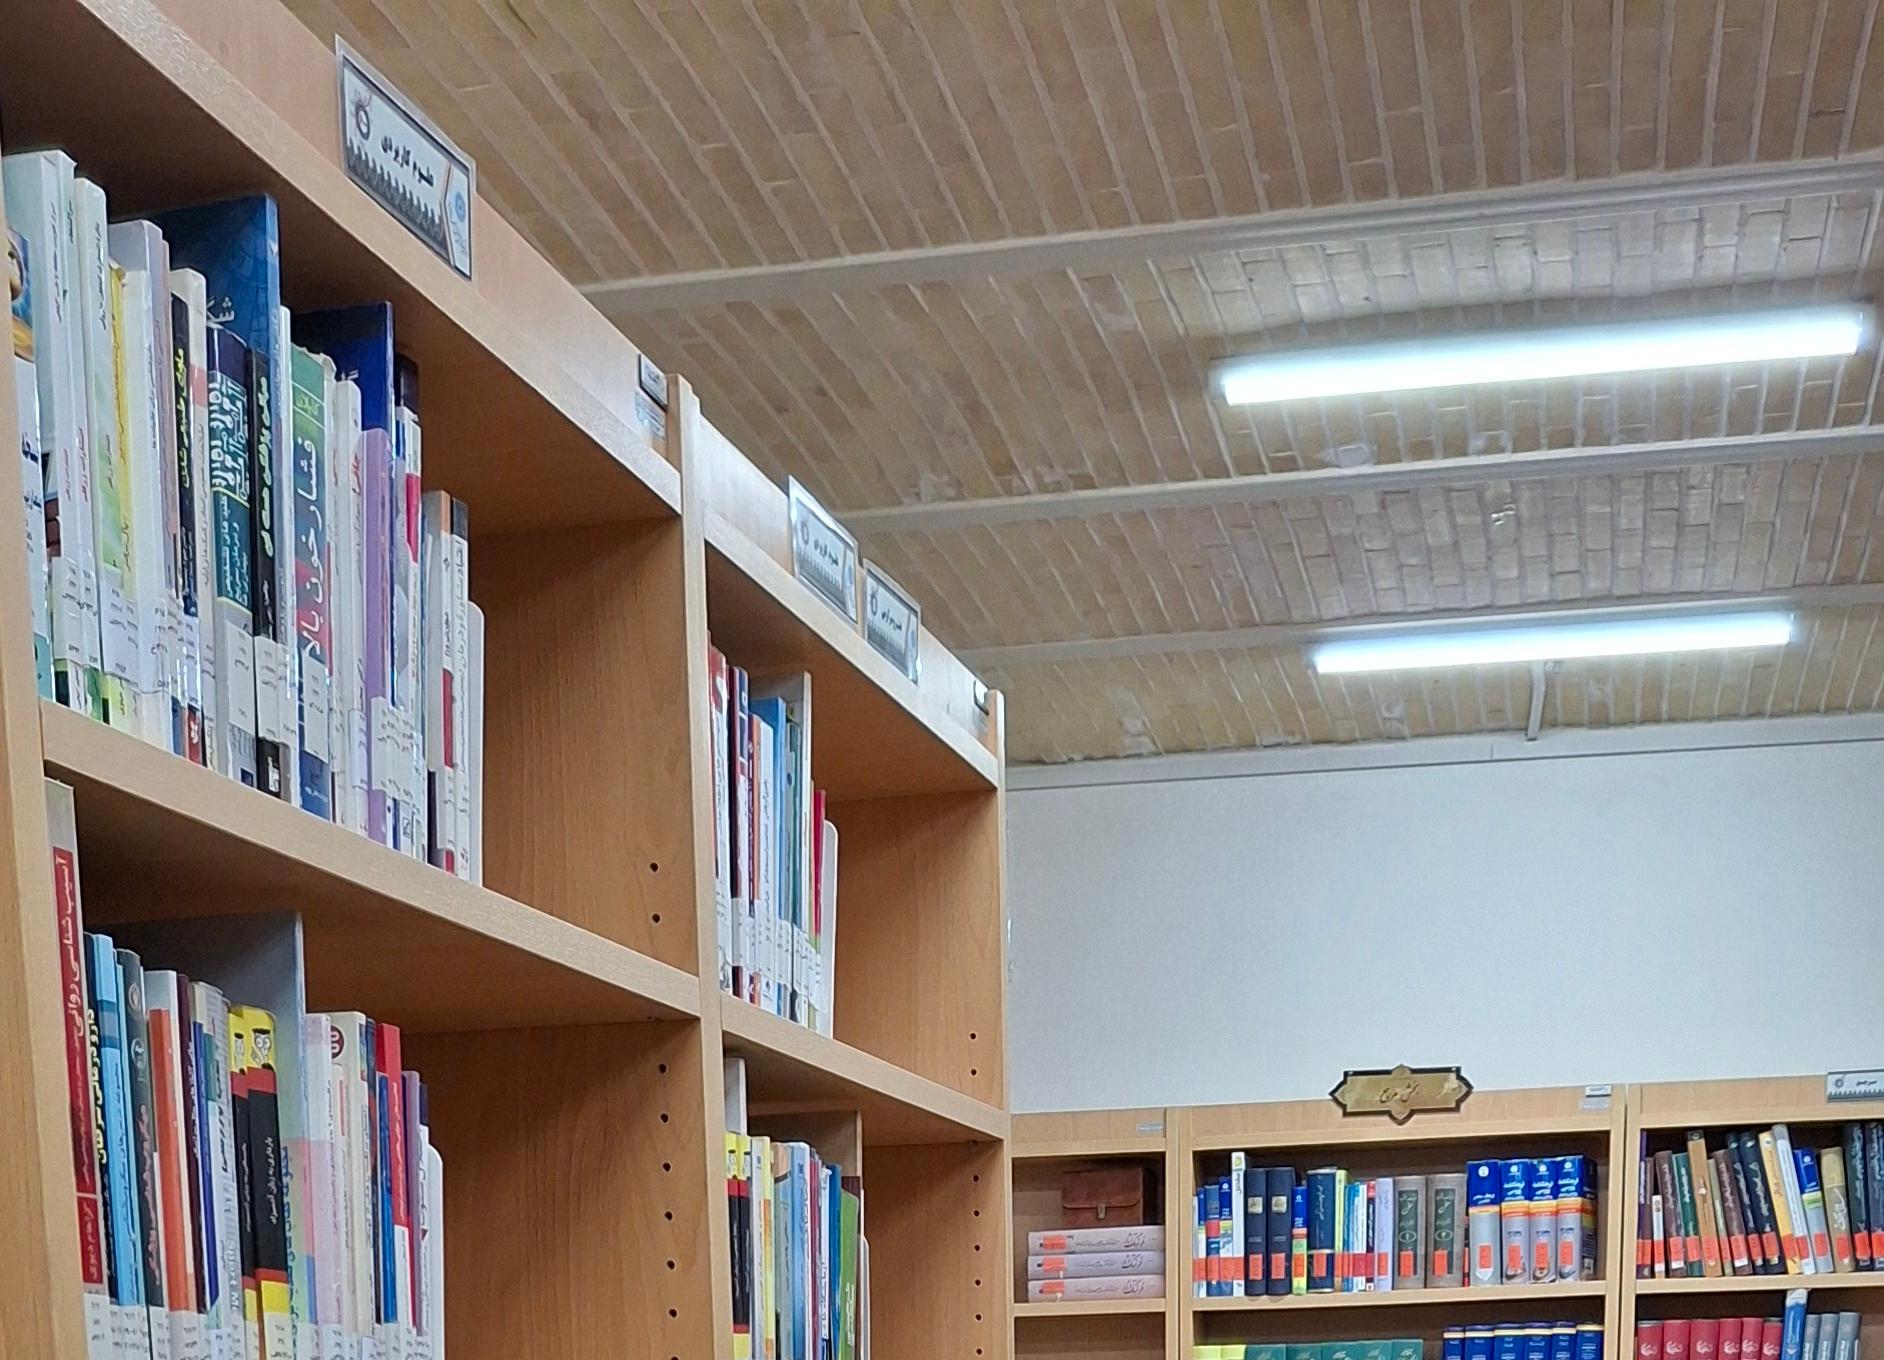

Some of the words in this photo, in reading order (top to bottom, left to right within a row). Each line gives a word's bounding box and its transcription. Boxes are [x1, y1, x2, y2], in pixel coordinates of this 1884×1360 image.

[295, 436, 322, 528] فشار
[221, 546, 233, 597] تشخیص
[298, 529, 324, 604] خون
[298, 607, 323, 656] بالا
[55, 854, 75, 915] آسیب
[61, 916, 81, 982] شناسی
[67, 983, 85, 1037] روانی
[227, 1239, 243, 1287] Sport
